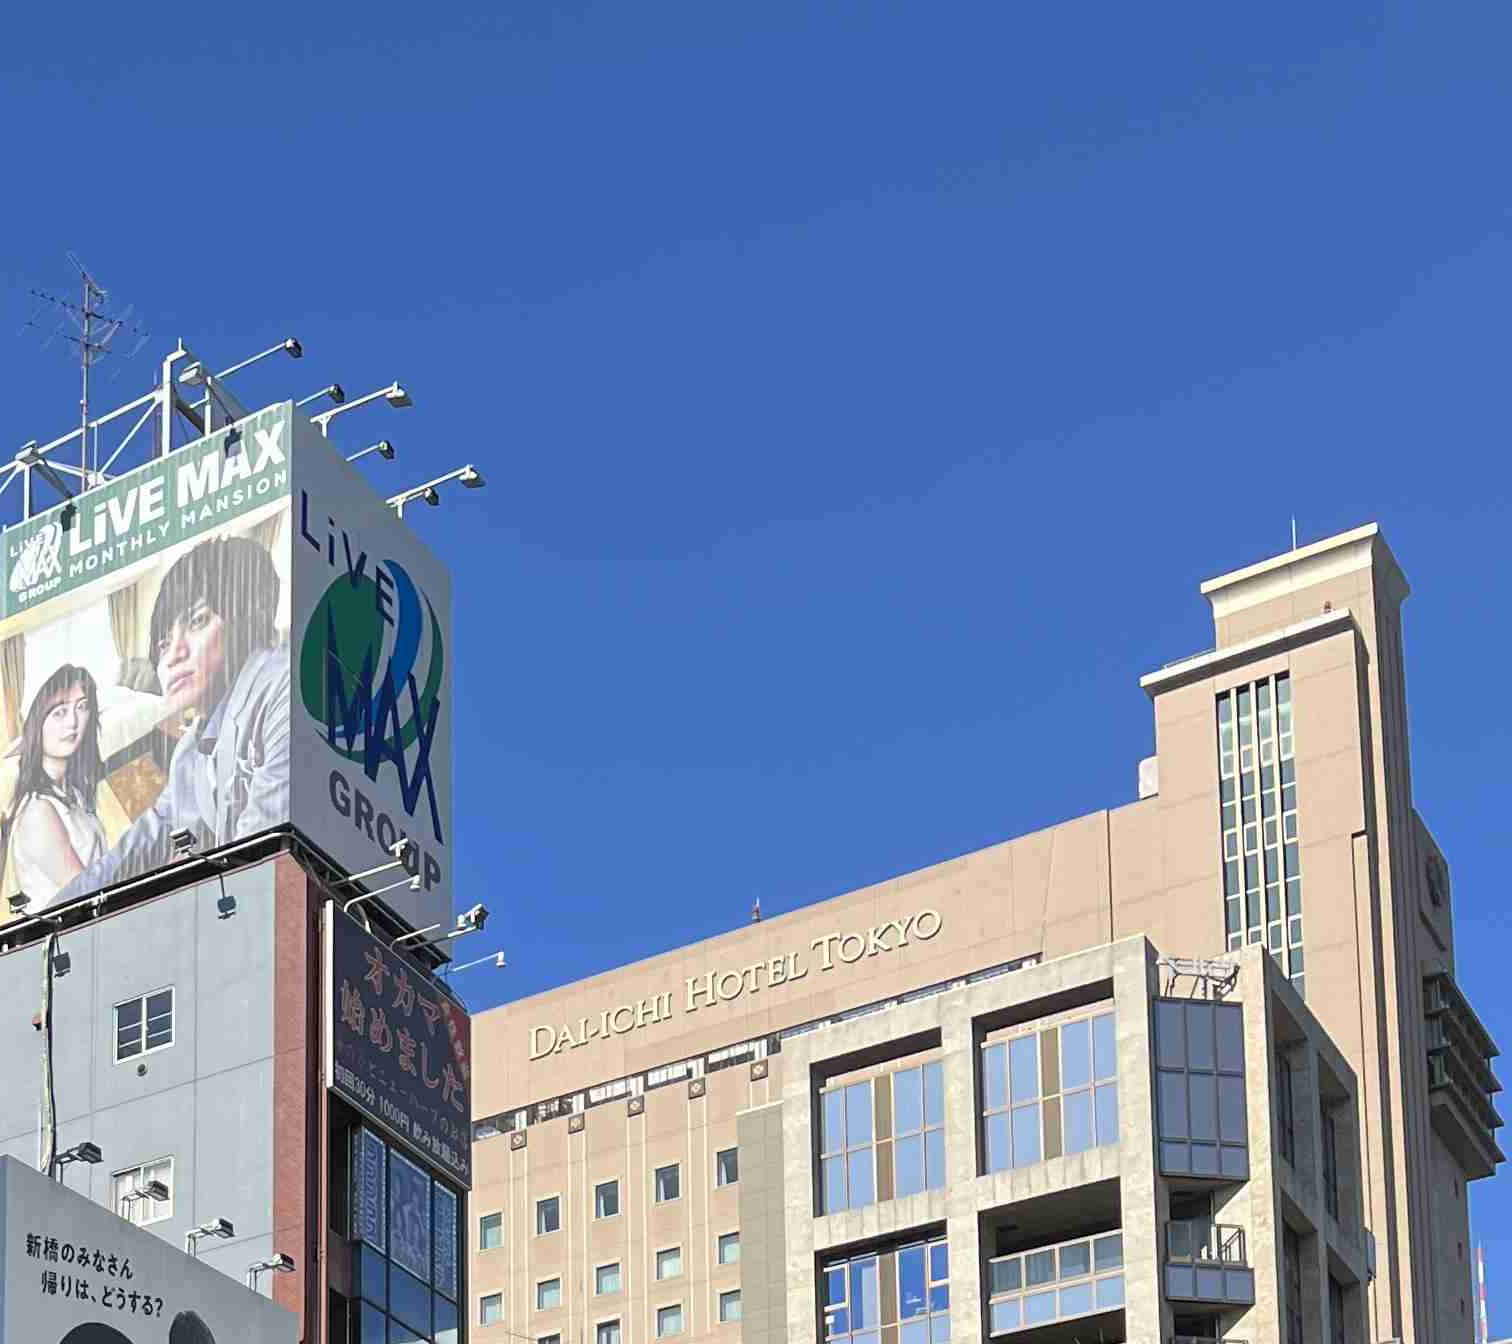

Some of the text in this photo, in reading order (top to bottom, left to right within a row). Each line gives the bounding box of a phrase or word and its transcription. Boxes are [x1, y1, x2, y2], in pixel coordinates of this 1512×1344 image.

[177, 420, 285, 508] MAX
[69, 470, 286, 577] MONTHLY MANSION
[18, 577, 62, 603] GROUP
[684, 952, 809, 1014] HOTEL
[810, 908, 943, 971] TOKYO
[25, 1233, 133, 1280] 新橋のみなさん
